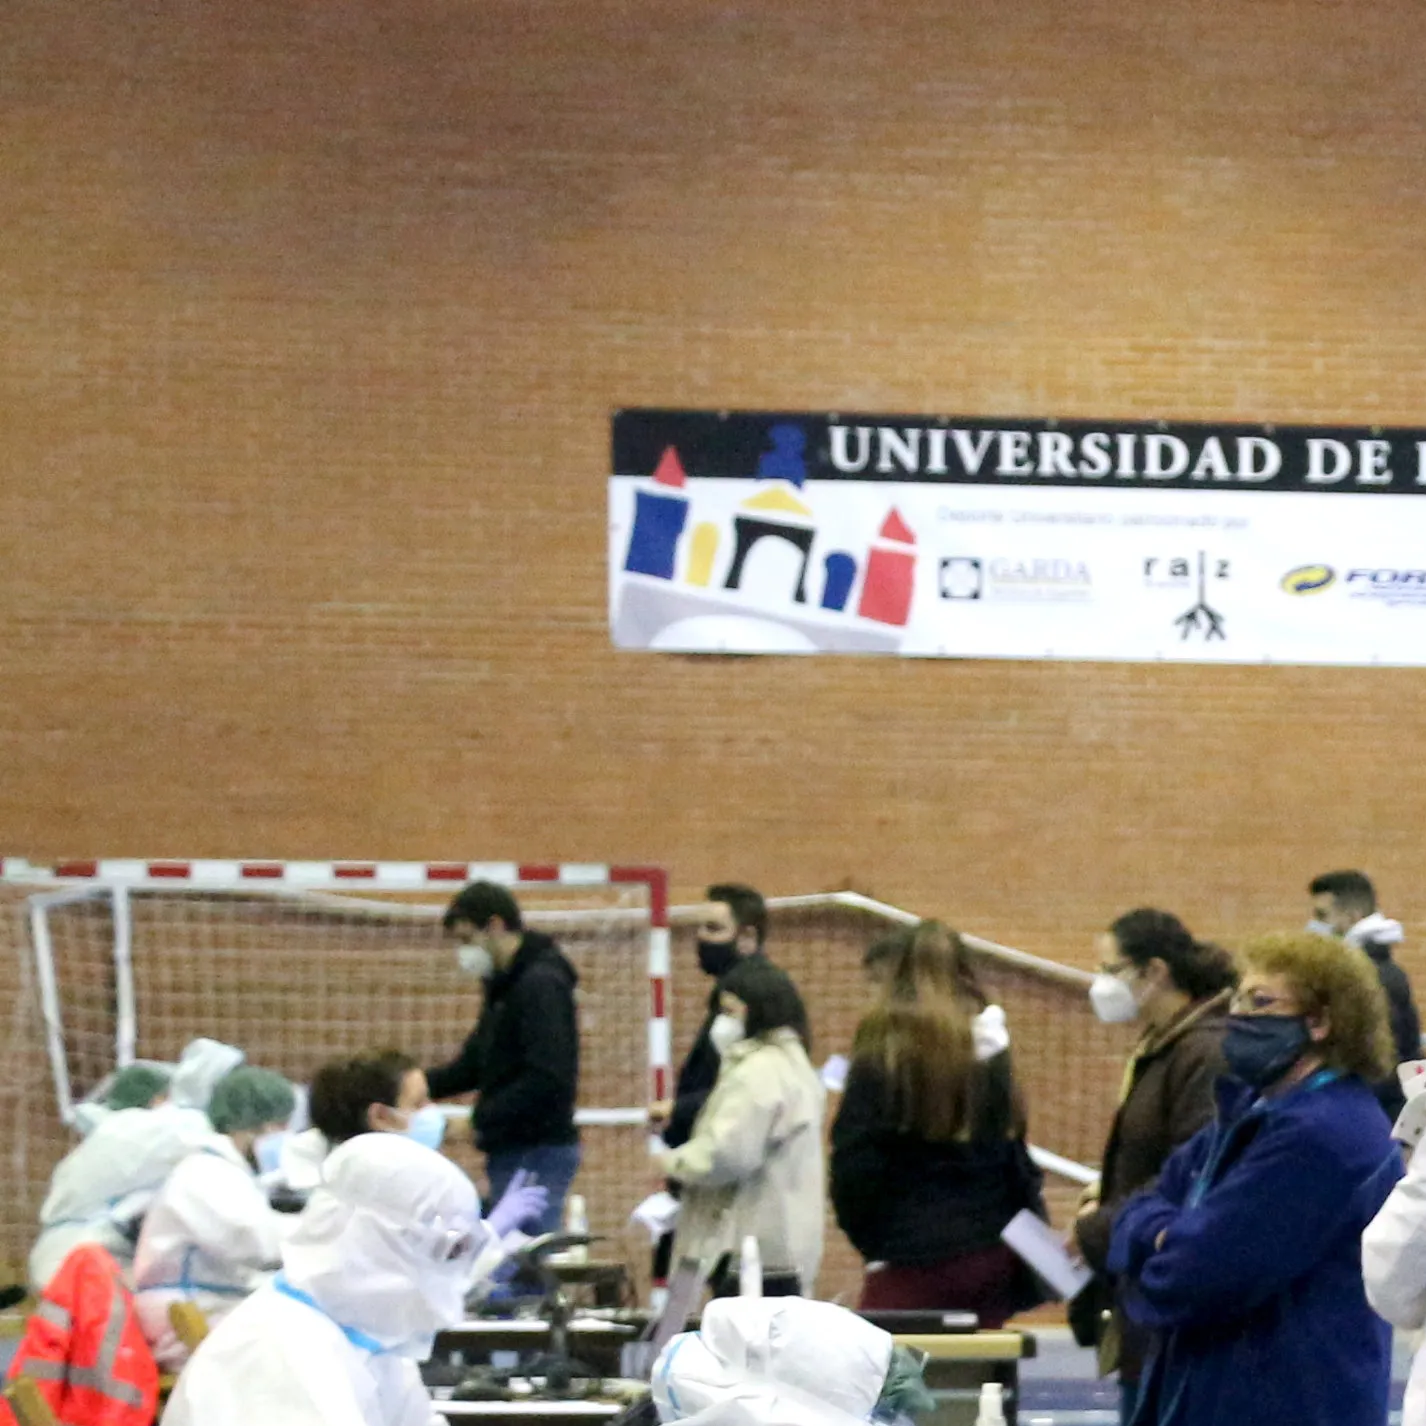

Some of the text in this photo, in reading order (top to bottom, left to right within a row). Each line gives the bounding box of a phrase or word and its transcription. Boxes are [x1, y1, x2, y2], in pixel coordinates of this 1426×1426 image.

[827, 424, 1282, 482] UNIVERSIDAD
[1305, 437, 1393, 486] DE
[989, 556, 1092, 585] GARDA
